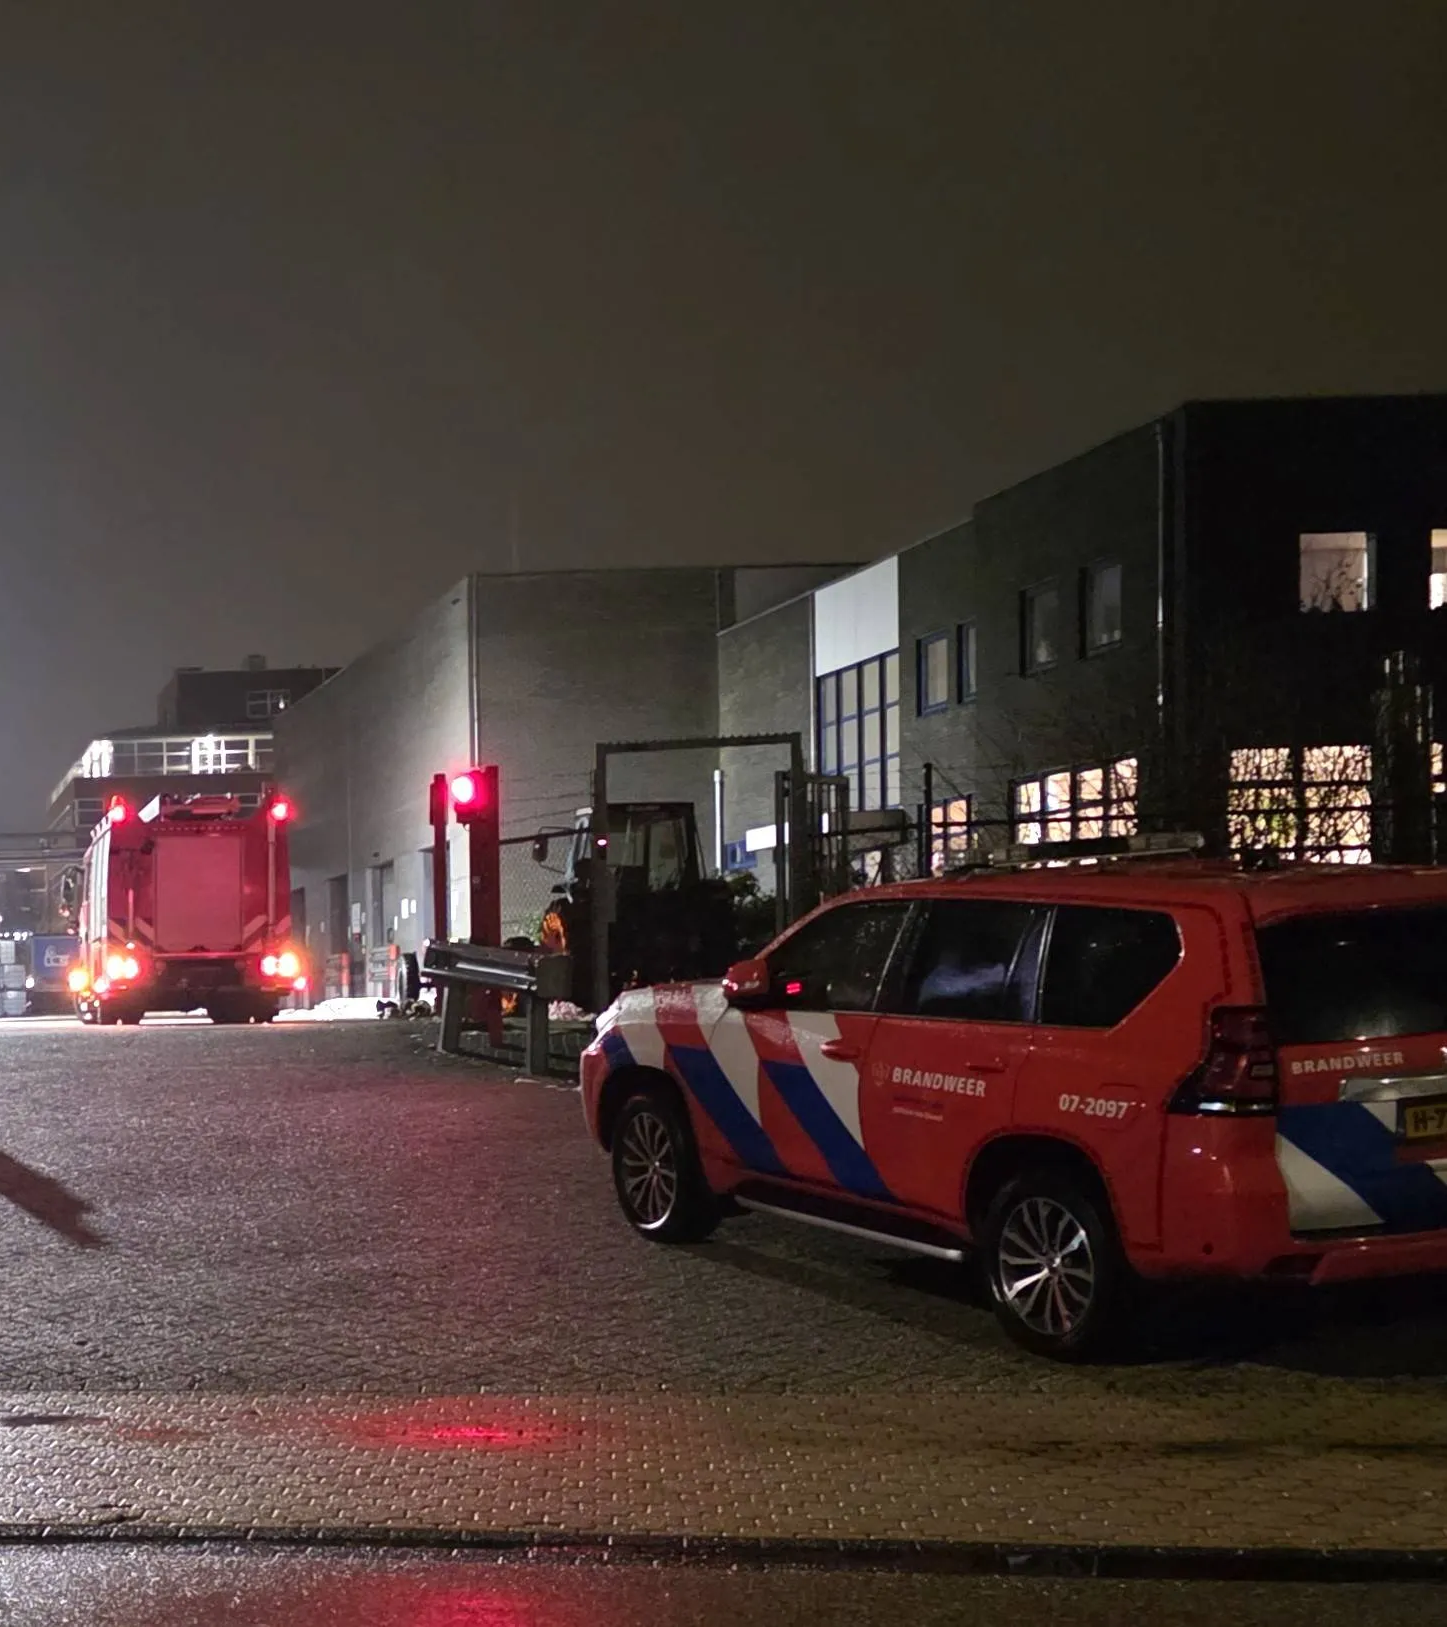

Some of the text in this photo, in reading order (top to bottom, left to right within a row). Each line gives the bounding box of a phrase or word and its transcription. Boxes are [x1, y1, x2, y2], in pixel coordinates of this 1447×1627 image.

[1288, 1051, 1404, 1075] BRANDWEER
[892, 1066, 986, 1098] BRANDWEER
[1059, 1093, 1129, 1119] 07-2097
